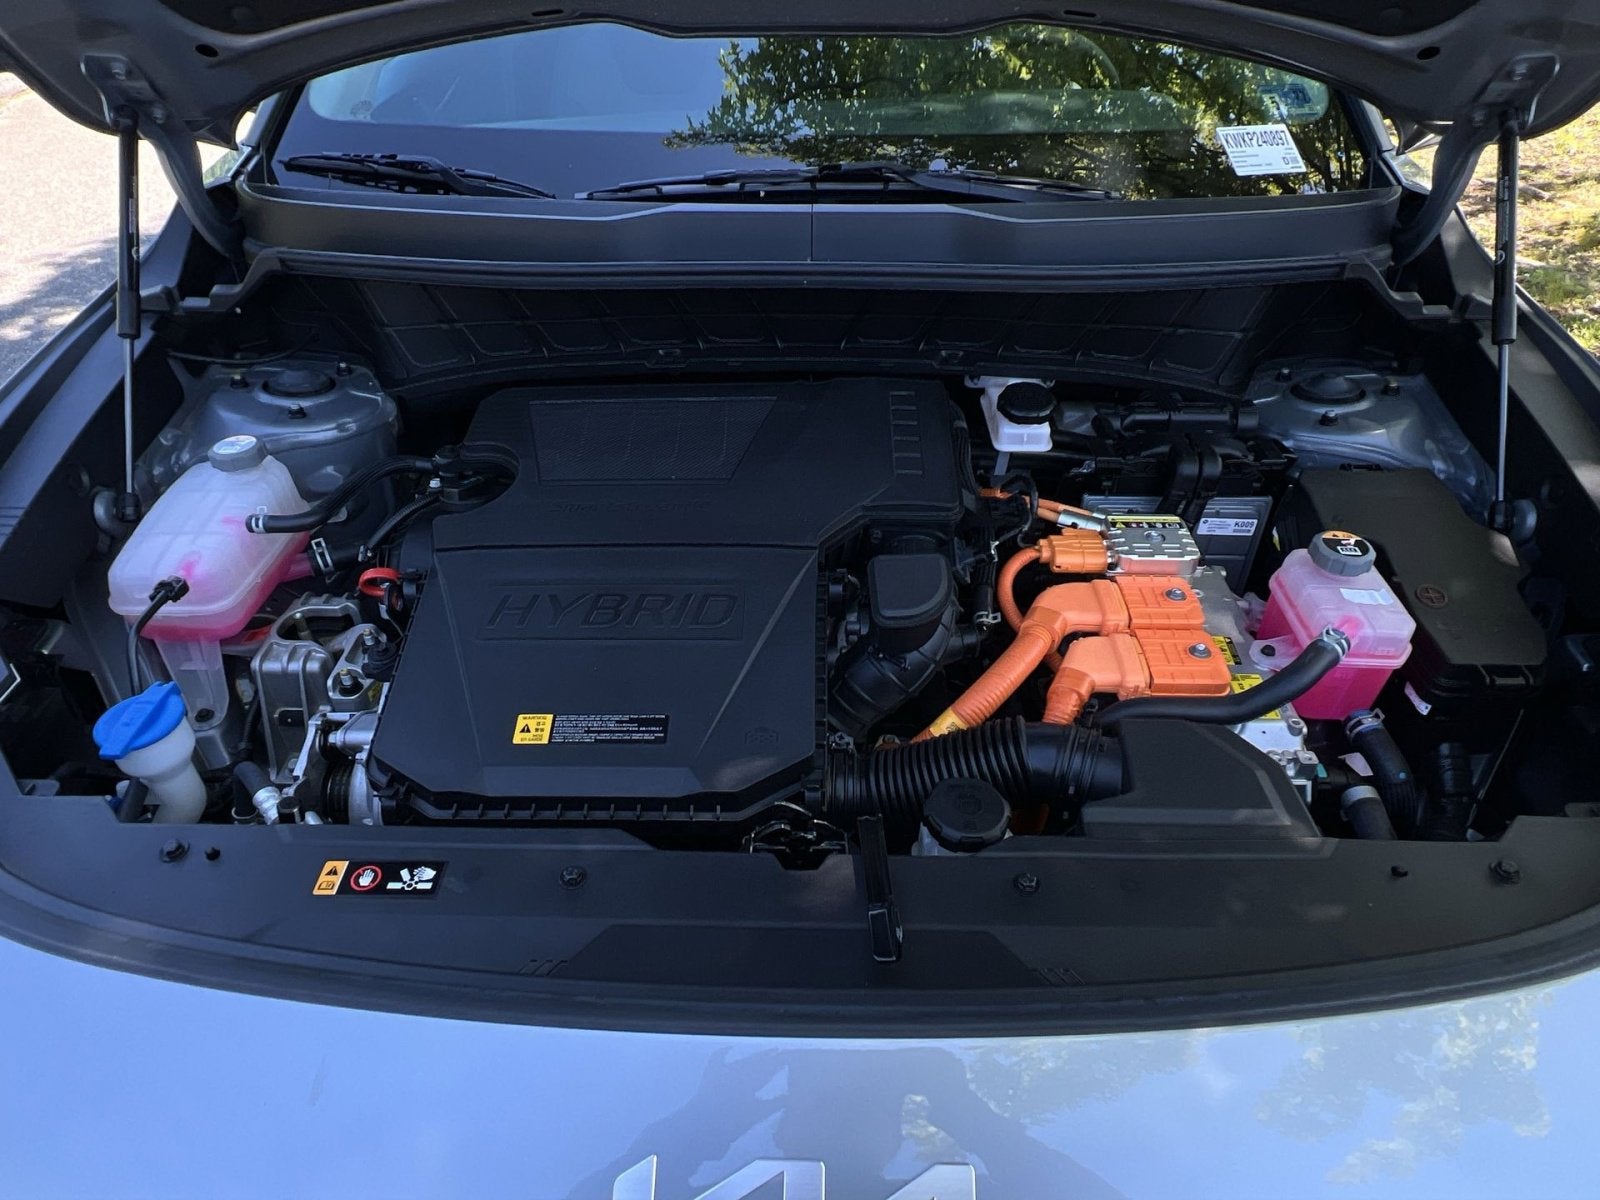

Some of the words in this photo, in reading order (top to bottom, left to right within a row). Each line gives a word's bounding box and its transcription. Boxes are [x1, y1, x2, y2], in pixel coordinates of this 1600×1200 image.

[1221, 130, 1290, 149] KWKP240897
[1233, 520, 1255, 529] K009
[485, 592, 739, 629] HYBRID
